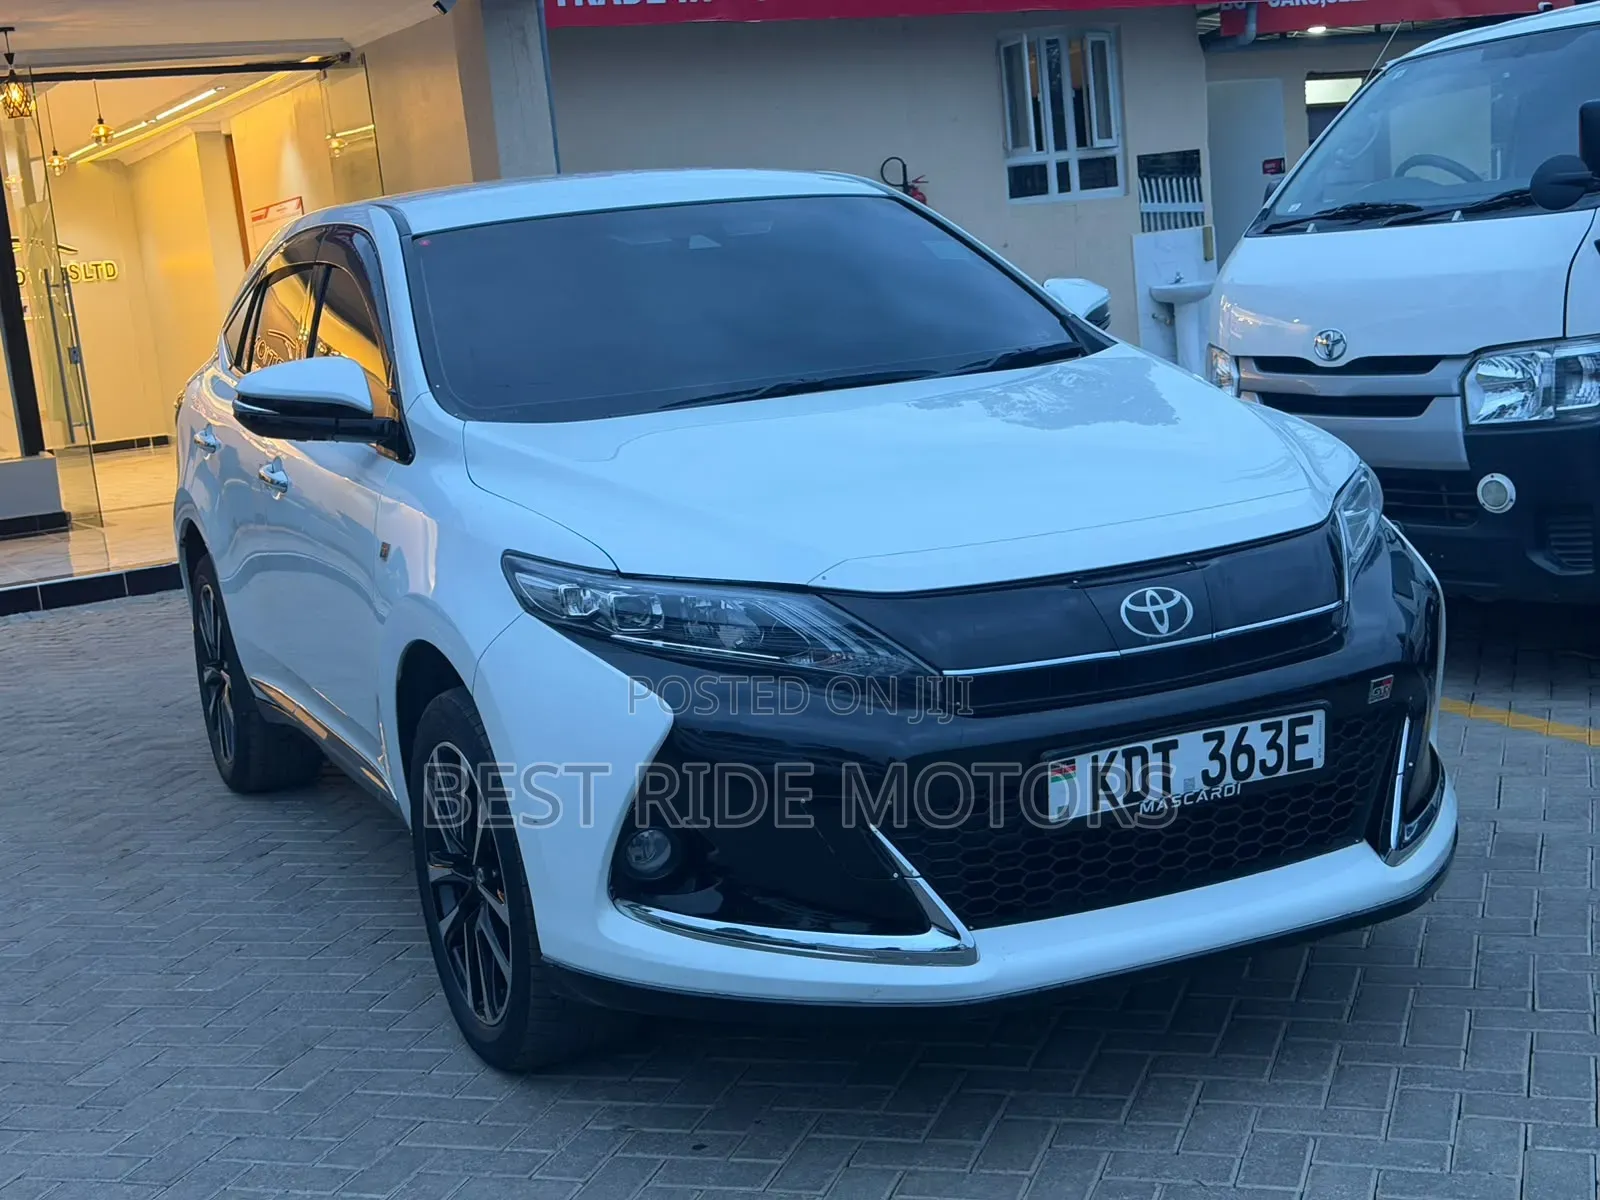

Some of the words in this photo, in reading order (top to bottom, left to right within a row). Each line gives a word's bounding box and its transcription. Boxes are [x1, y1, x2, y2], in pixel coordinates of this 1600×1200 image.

[1090, 739, 1179, 812] KDT
[1201, 715, 1314, 787] 363E
[1139, 782, 1242, 815] MASCARDI
